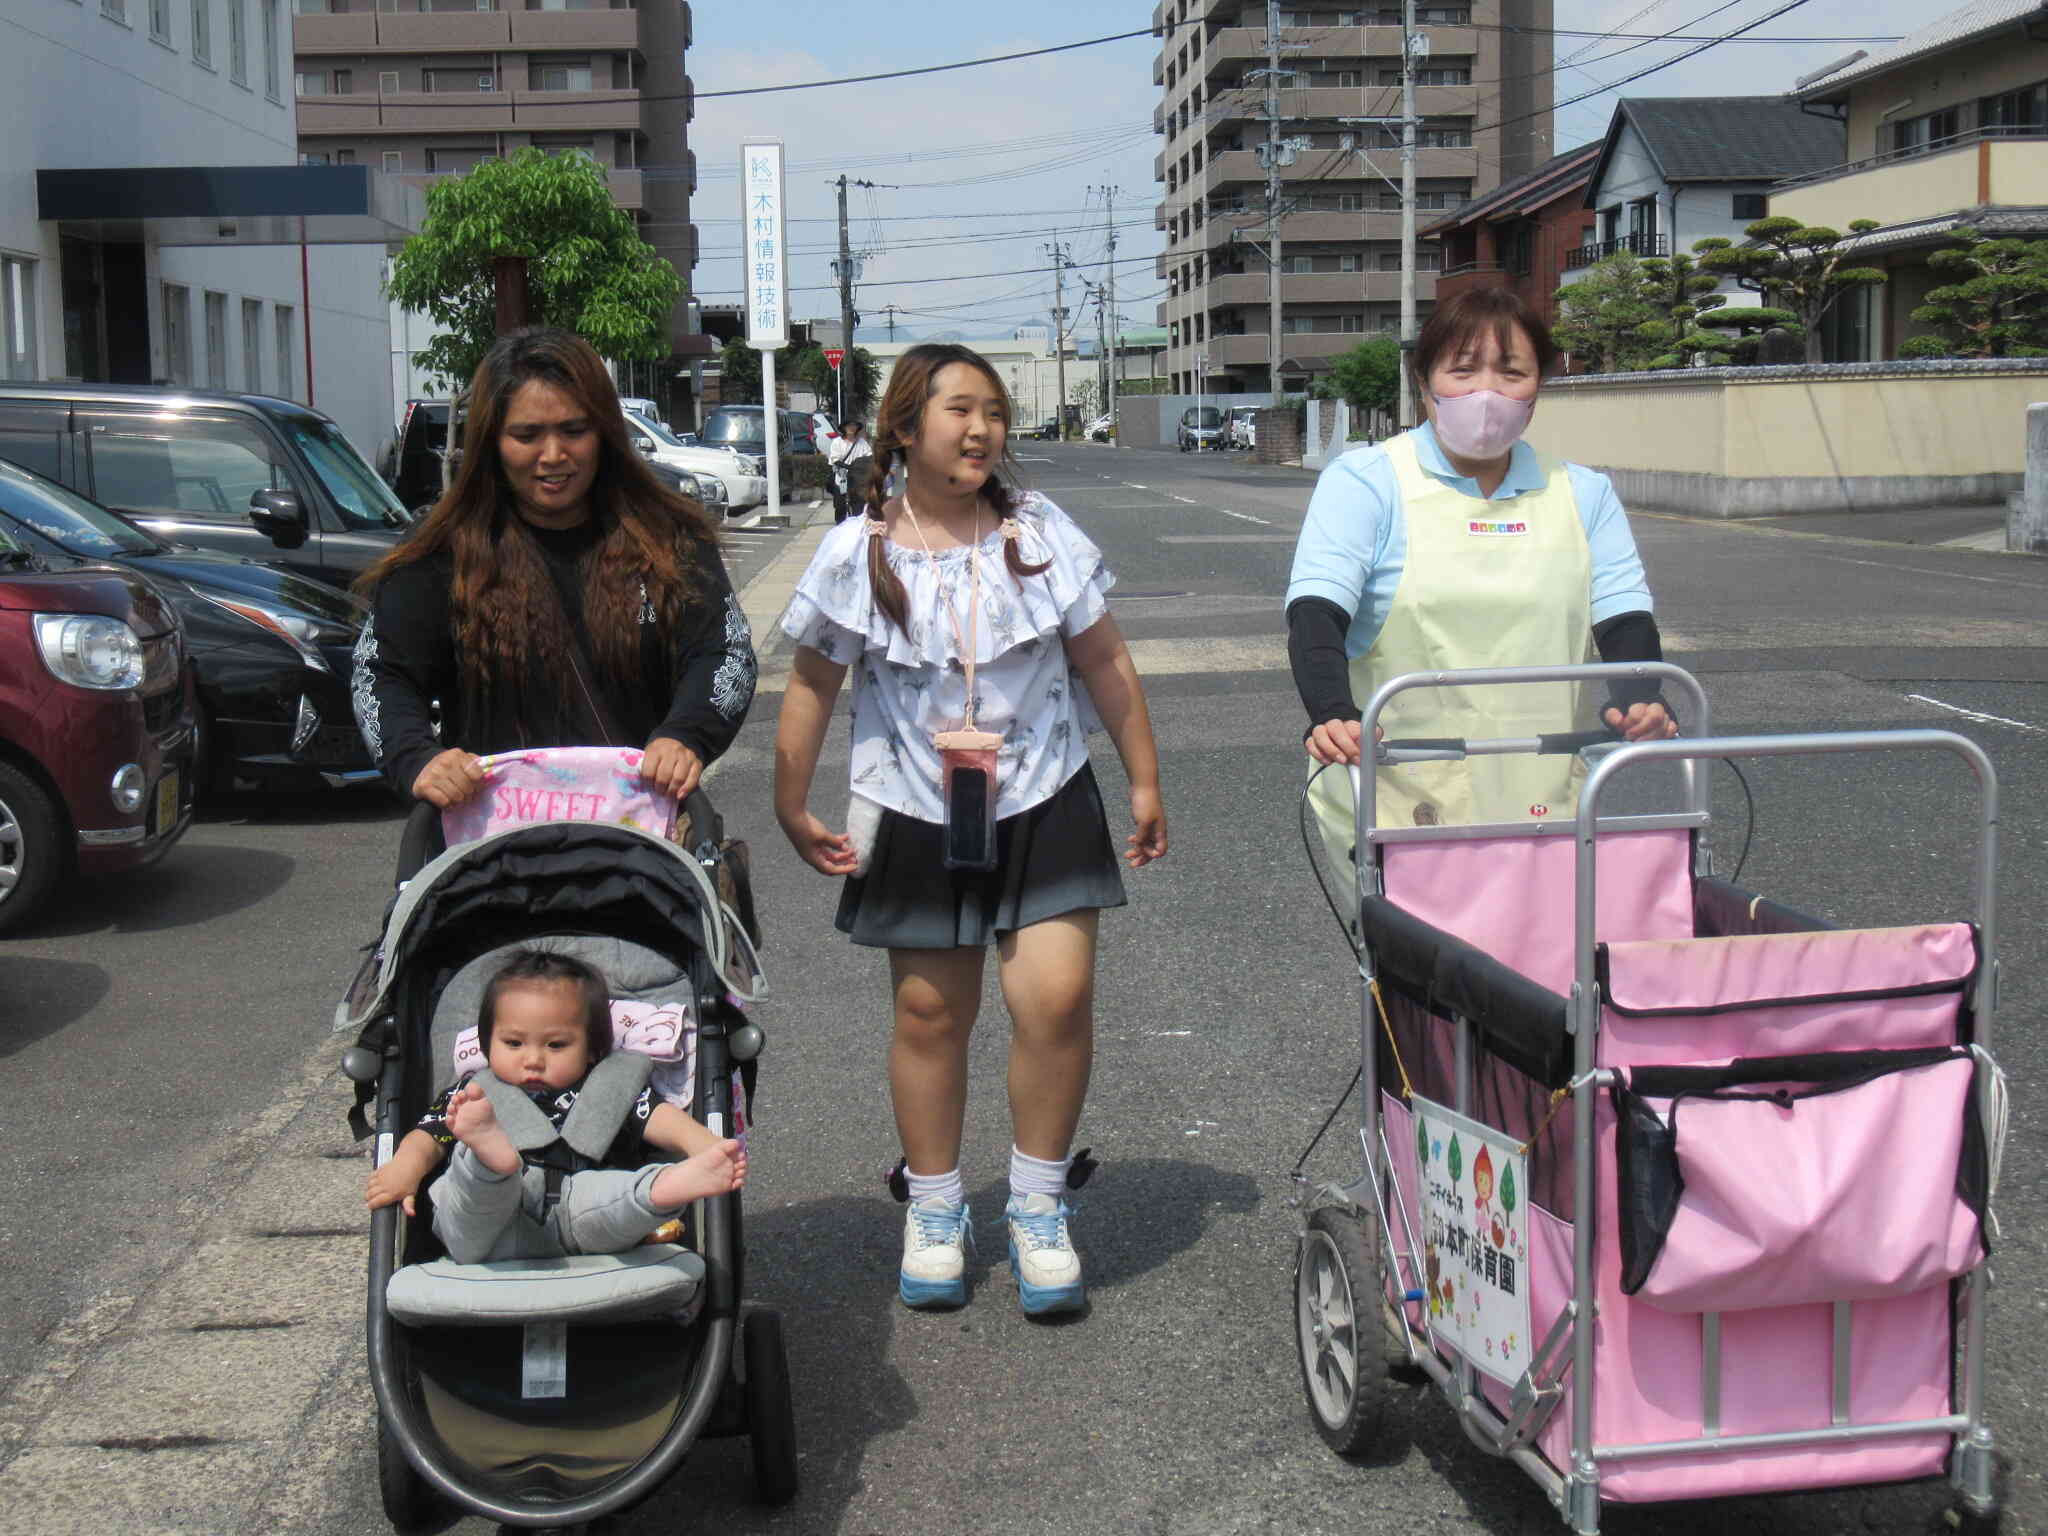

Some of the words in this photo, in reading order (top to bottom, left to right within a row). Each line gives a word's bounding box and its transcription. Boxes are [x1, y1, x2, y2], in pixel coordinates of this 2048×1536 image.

[753, 192, 776, 329] 木村情報技術
[495, 786, 607, 821] SWEET
